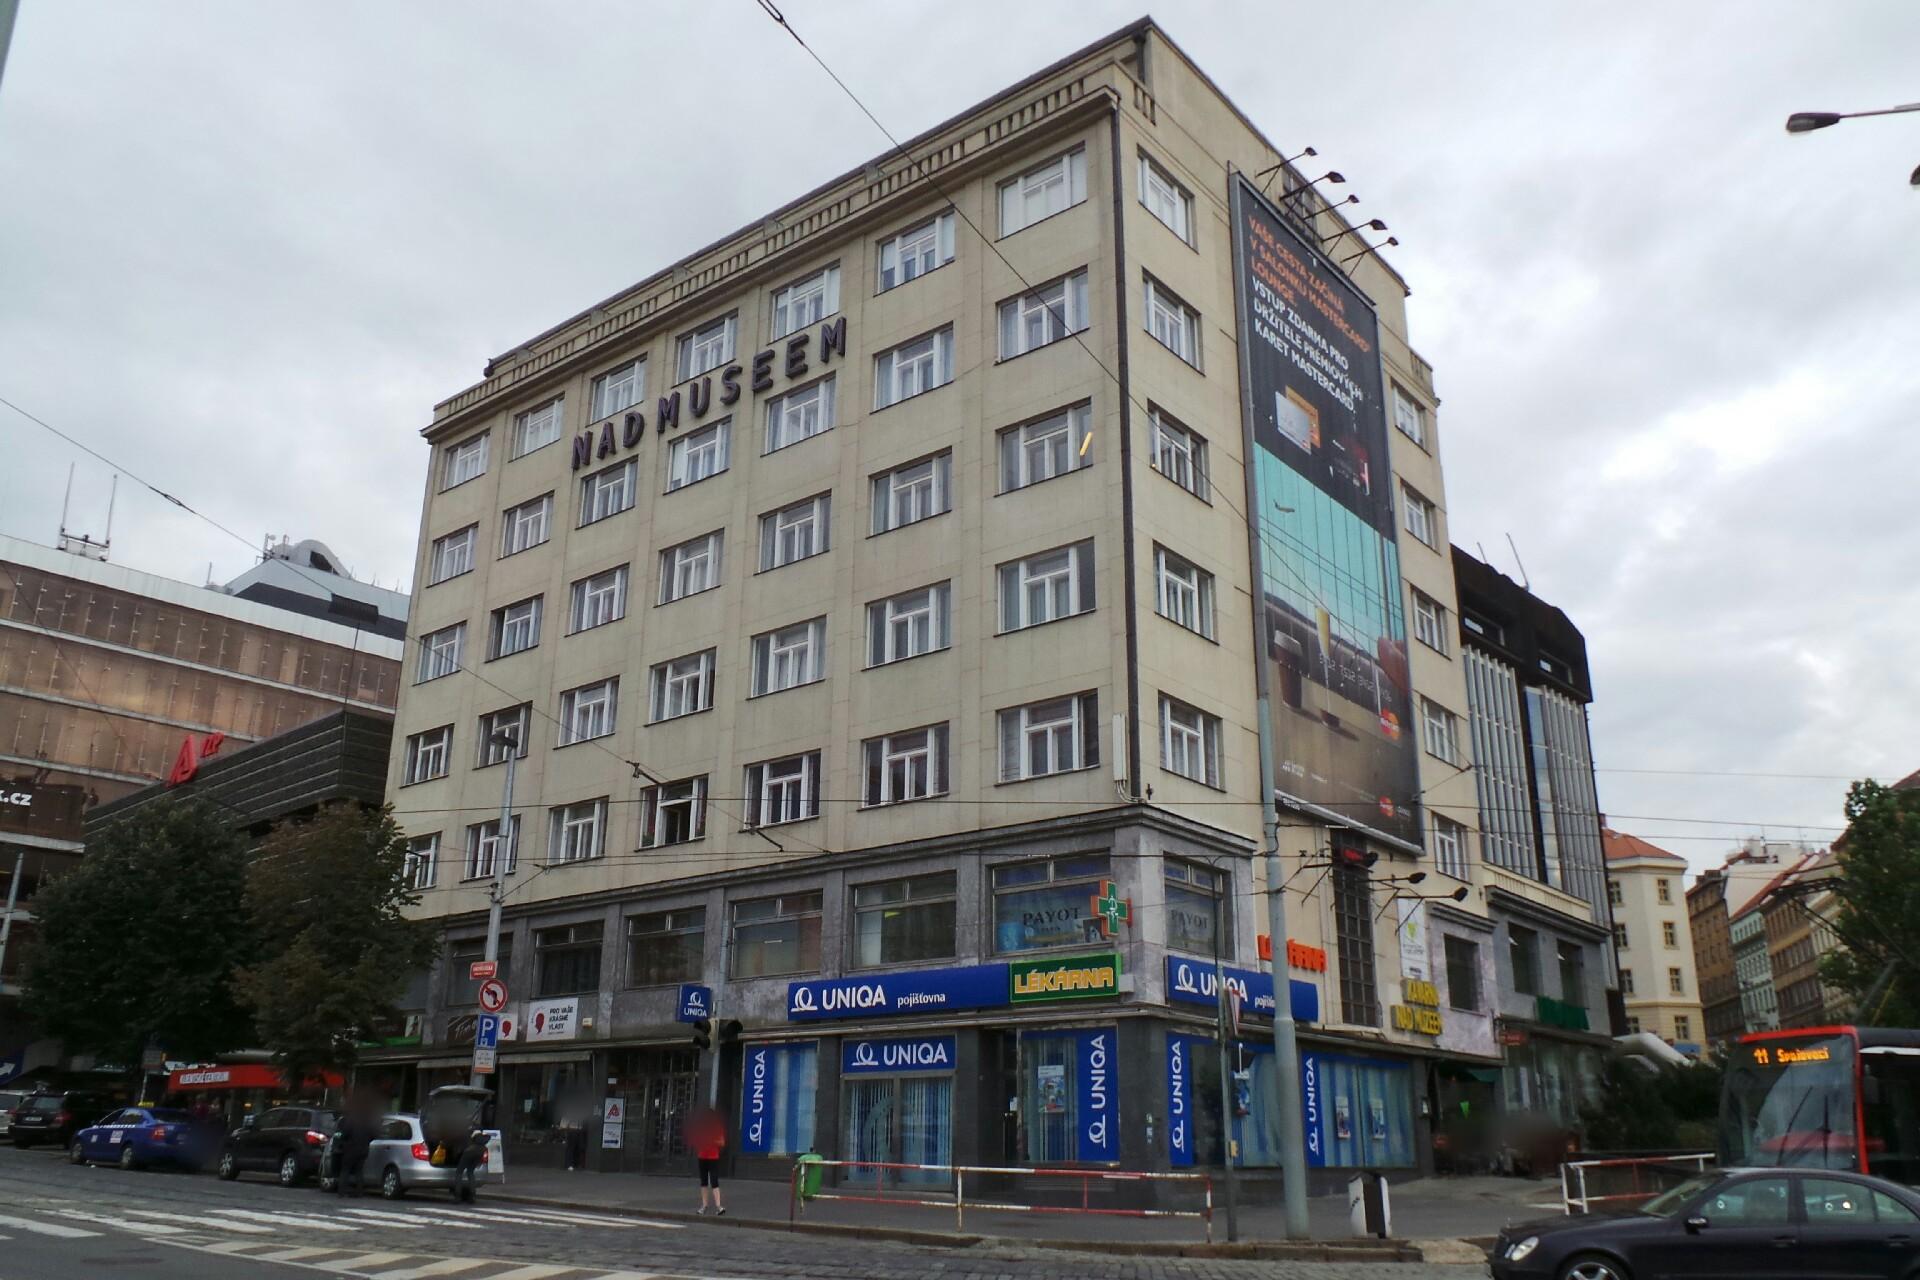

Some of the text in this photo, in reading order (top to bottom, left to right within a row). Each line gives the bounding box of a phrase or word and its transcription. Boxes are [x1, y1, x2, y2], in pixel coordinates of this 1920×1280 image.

[1249, 235, 1258, 250] V
[1276, 243, 1308, 279] CESTA
[1252, 275, 1349, 370] VSTUP ZDARMA PRO
[1254, 318, 1289, 356] KARET
[1254, 297, 1364, 401] DRŽITELE PRÉMIOVÝCH
[571, 316, 847, 470] NAD MUSEEM
[1023, 907, 1081, 926] PAYOT
[1170, 909, 1208, 930] PAYOT
[1257, 934, 1328, 974] LÁRNA
[822, 984, 946, 1011] UNIQA pojišťovna
[1014, 966, 1114, 994] LÉKÁRNA
[683, 1007, 708, 1018] UNIQA
[883, 1042, 949, 1067] UNIQA
[1090, 1034, 1106, 1109] UNIQA
[1753, 1047, 1770, 1064] 11
[752, 1050, 766, 1114] UNIQA
[1170, 1040, 1184, 1115] UNIQA
[1305, 1057, 1317, 1123] UNIQA
